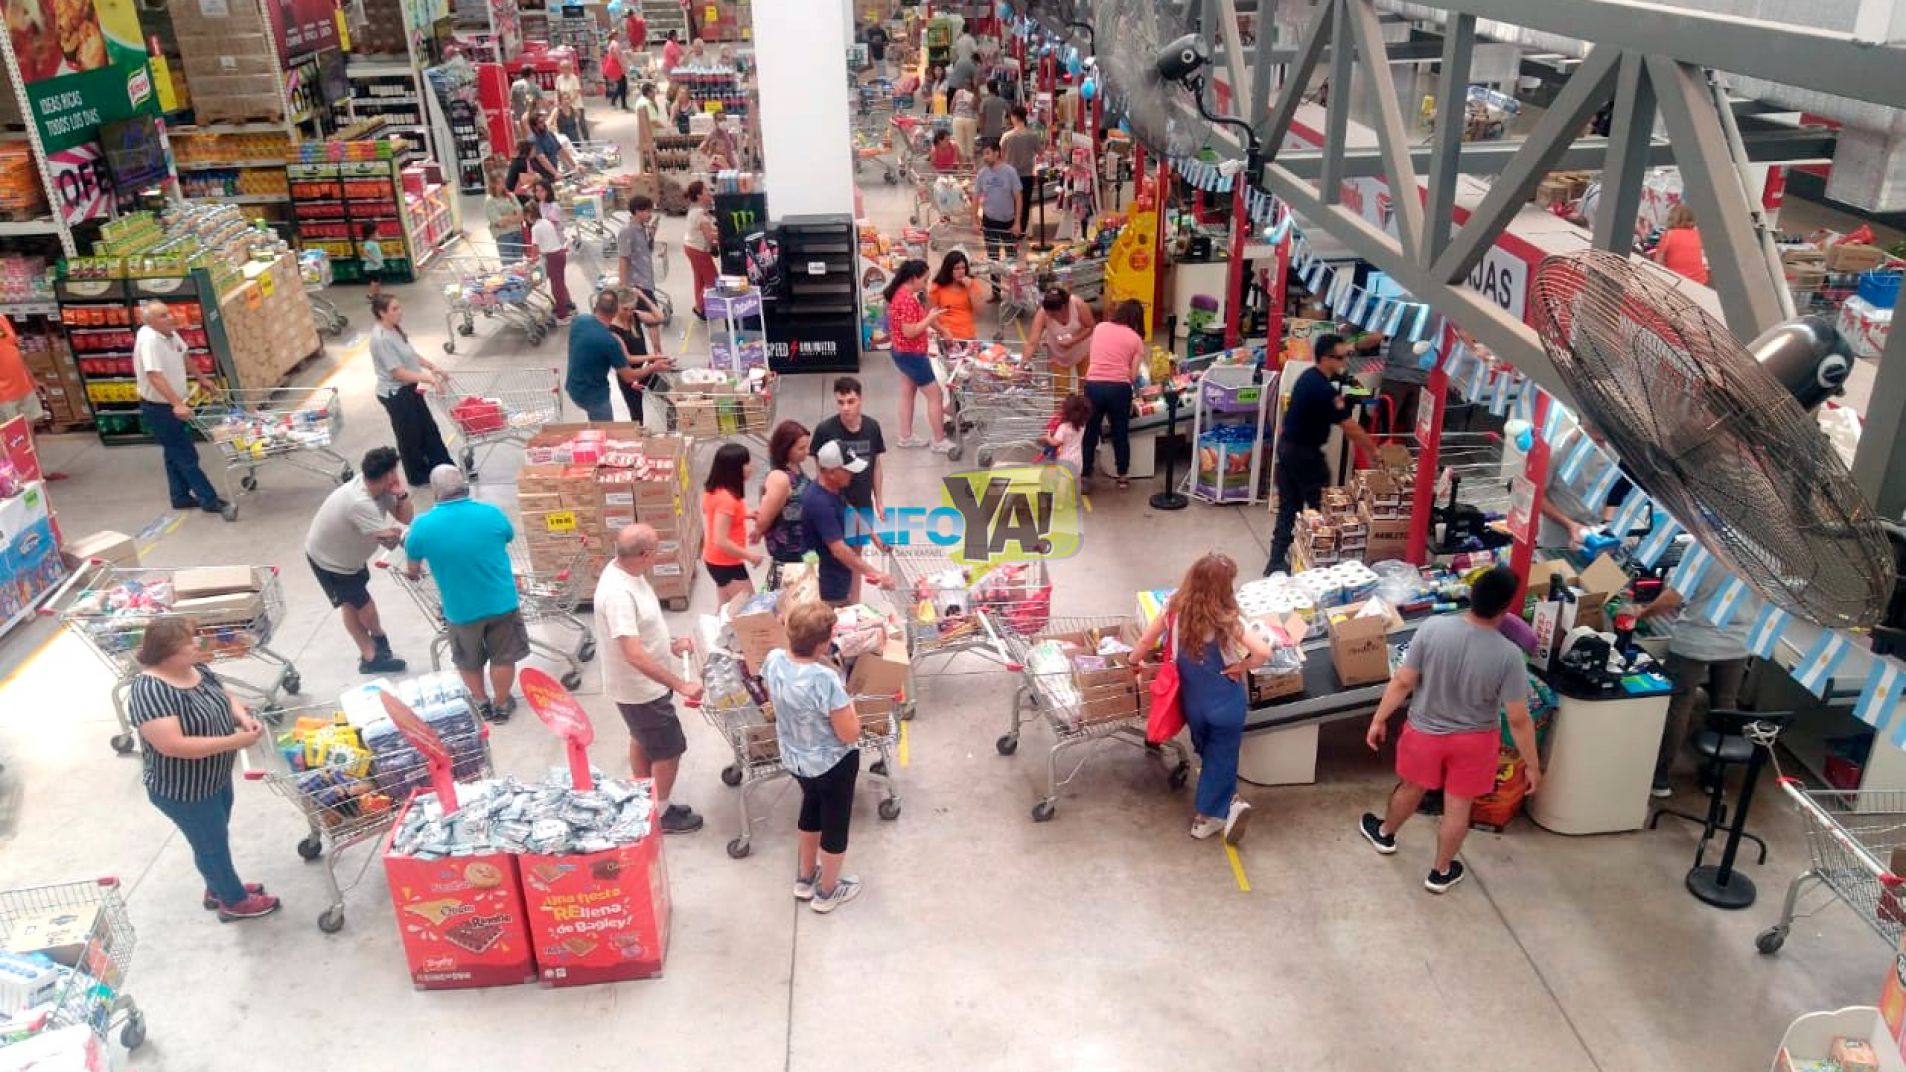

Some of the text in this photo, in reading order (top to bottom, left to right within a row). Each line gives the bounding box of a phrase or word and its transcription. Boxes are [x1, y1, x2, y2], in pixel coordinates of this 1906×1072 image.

[40, 90, 82, 115] IDEAS RICAS
[45, 115, 71, 136] TODOS
[69, 111, 84, 130] LOS
[1467, 257, 1512, 310] JAS
